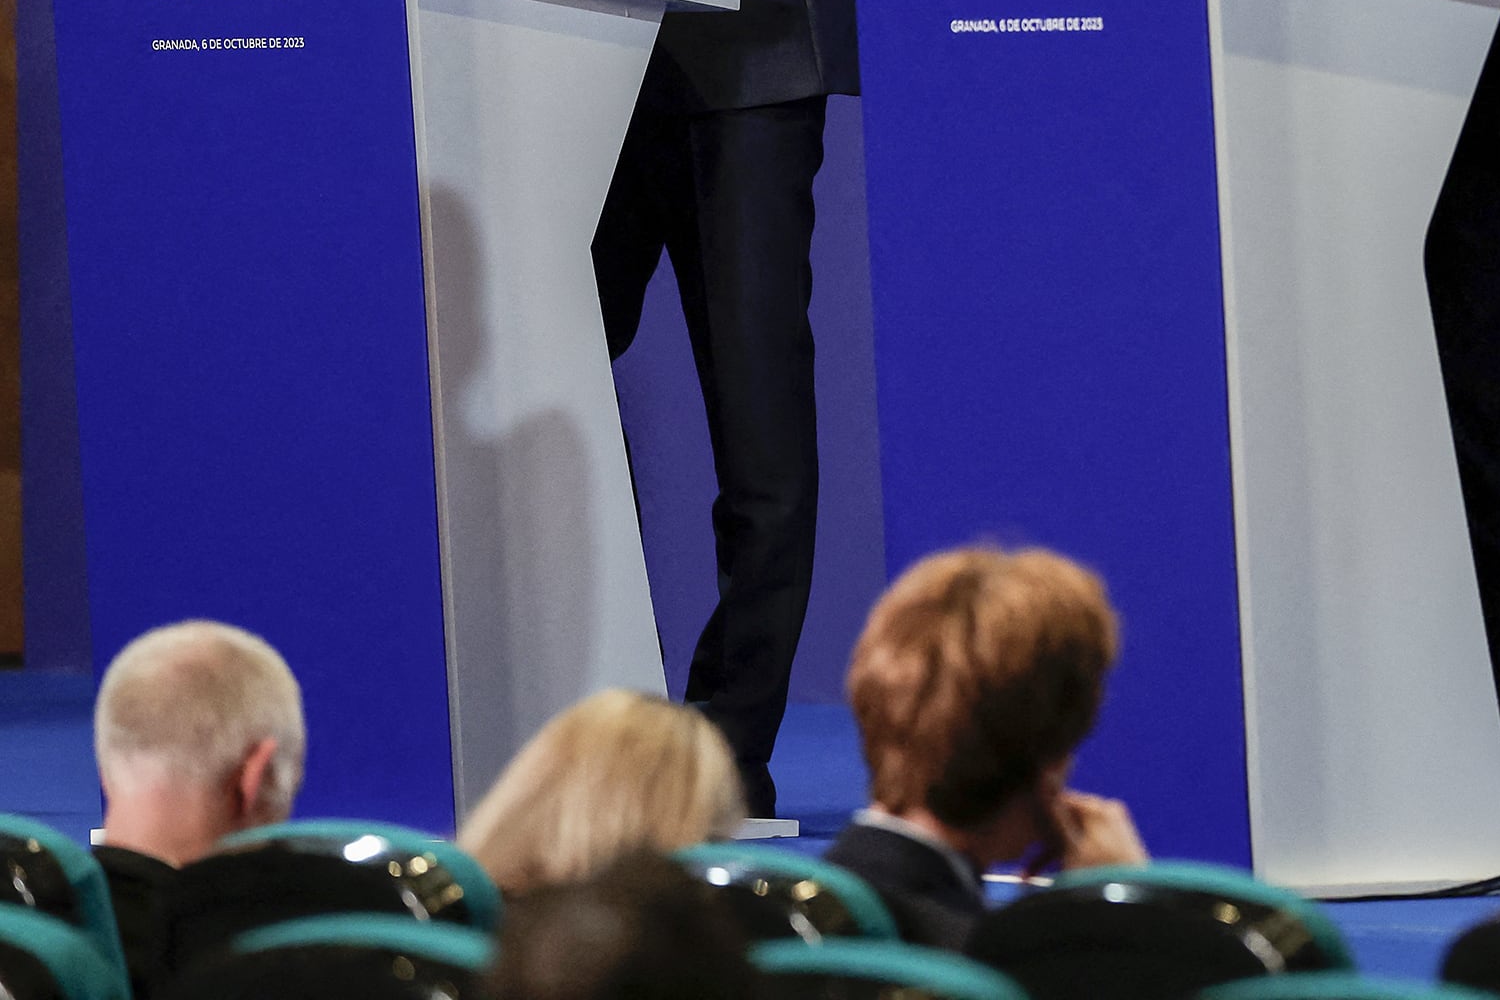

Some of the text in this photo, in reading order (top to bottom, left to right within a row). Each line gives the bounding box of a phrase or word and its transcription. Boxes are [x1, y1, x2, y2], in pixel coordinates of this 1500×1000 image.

[950, 19, 999, 33] GRANADA,
[999, 19, 1007, 32] 6
[1007, 18, 1021, 32] DE
[1021, 17, 1066, 31] OCTUBRE
[1066, 17, 1080, 31] DE
[152, 37, 305, 52] GRANADA, 6 DE OCTUBRE DE 2023
